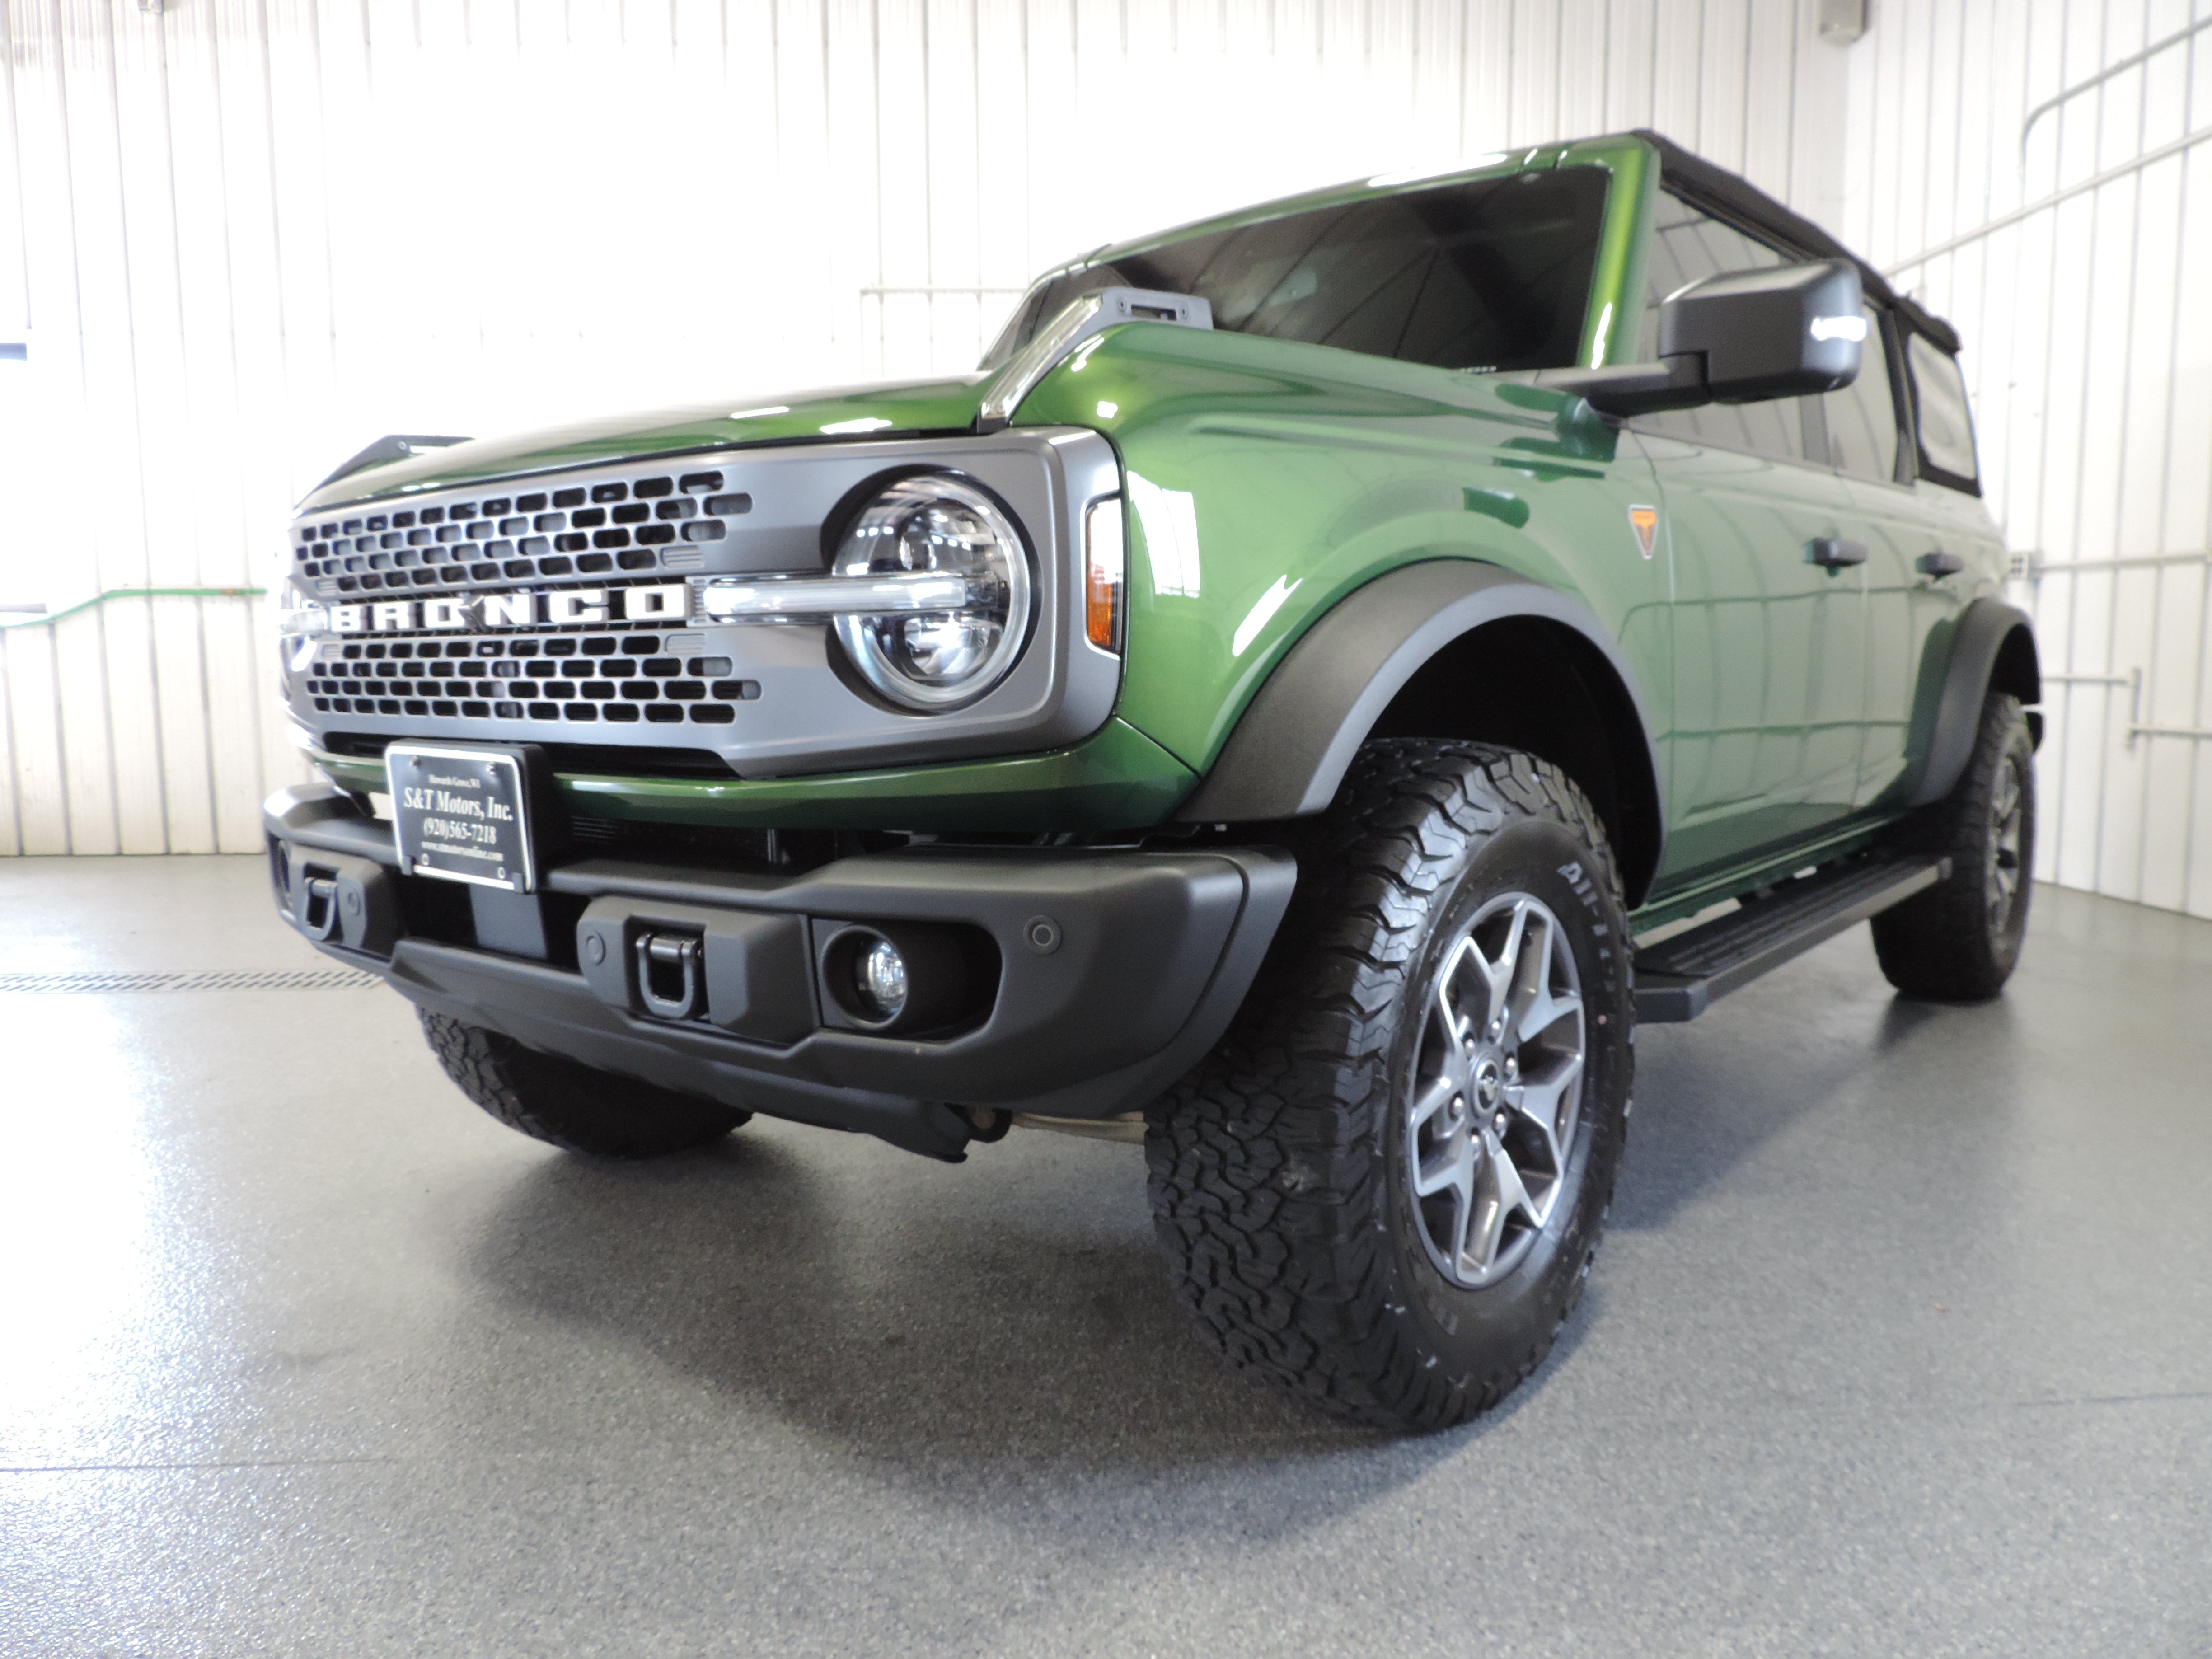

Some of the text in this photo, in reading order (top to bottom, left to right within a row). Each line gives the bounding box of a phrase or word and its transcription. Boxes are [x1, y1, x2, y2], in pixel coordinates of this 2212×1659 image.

[330, 584, 690, 632] BRONCO
[403, 787, 513, 821] S&T Motors, Inc.
